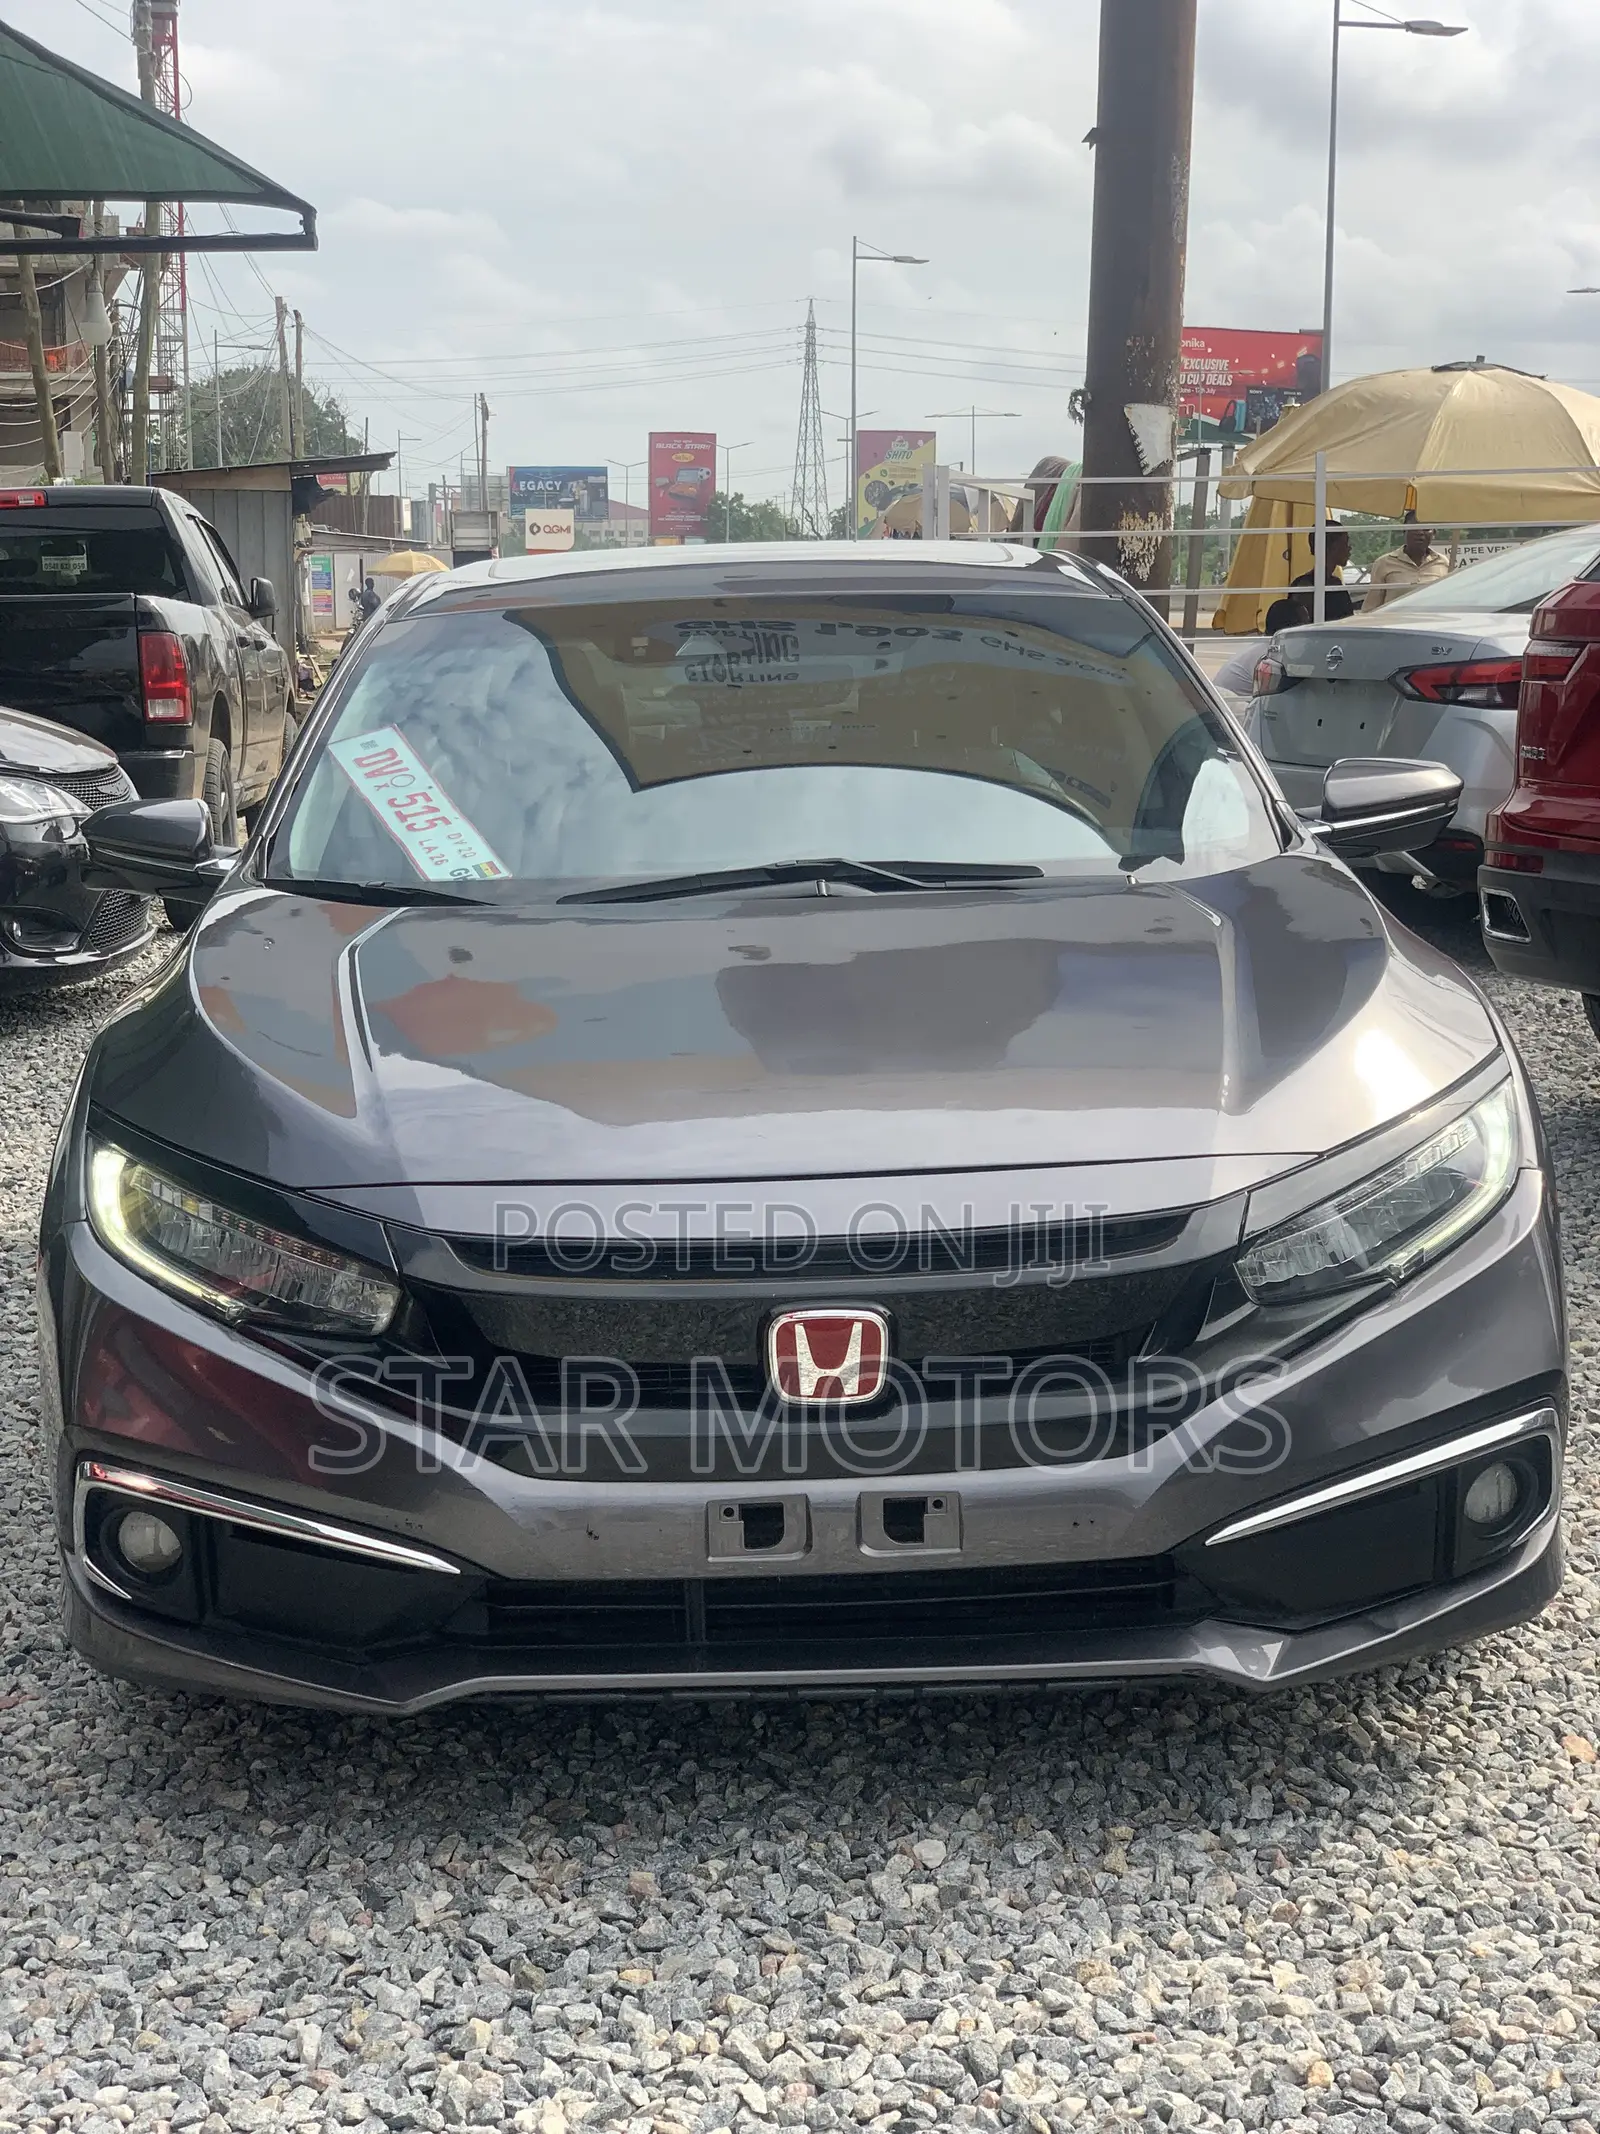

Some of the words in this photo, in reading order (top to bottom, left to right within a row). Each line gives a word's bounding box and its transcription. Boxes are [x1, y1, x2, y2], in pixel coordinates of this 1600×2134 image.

[1184, 358, 1230, 370] EXCLUSIVE
[1206, 373, 1233, 386] DEALS
[886, 450, 913, 460] SHITO
[543, 524, 571, 534] QGMI
[1464, 546, 1484, 554] PEE
[1431, 646, 1452, 655] SV
[353, 748, 410, 778] DV
[387, 792, 452, 832] 515
[418, 839, 439, 854] LA
